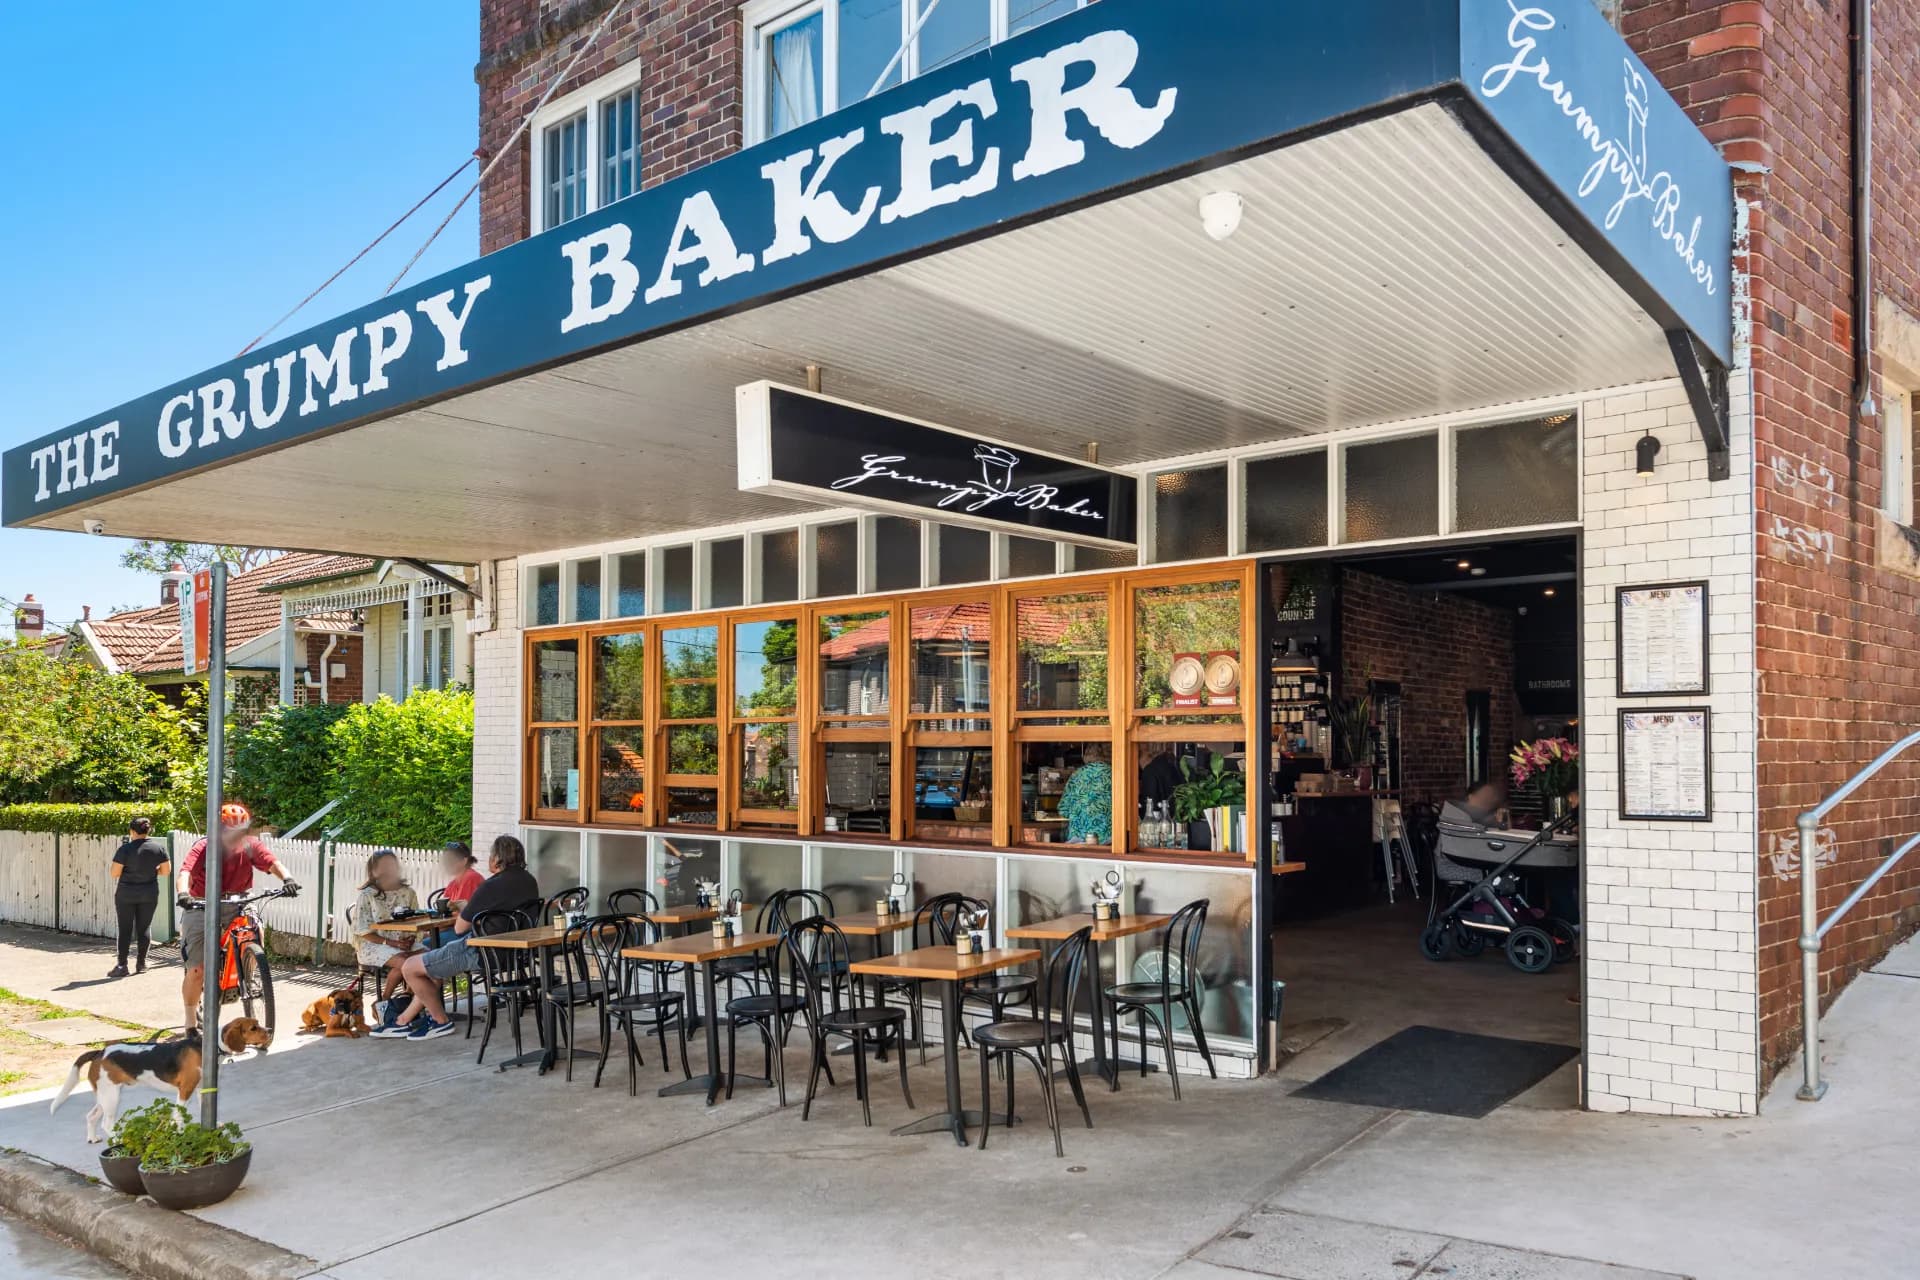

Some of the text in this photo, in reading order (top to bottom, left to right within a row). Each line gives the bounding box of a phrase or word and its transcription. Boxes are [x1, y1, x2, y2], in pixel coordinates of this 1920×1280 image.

[30, 29, 1178, 502] THE GRUMPY BAKER
[830, 453, 1104, 520] Grumpy Baker
[1528, 679, 1571, 689] BATHROOMS
